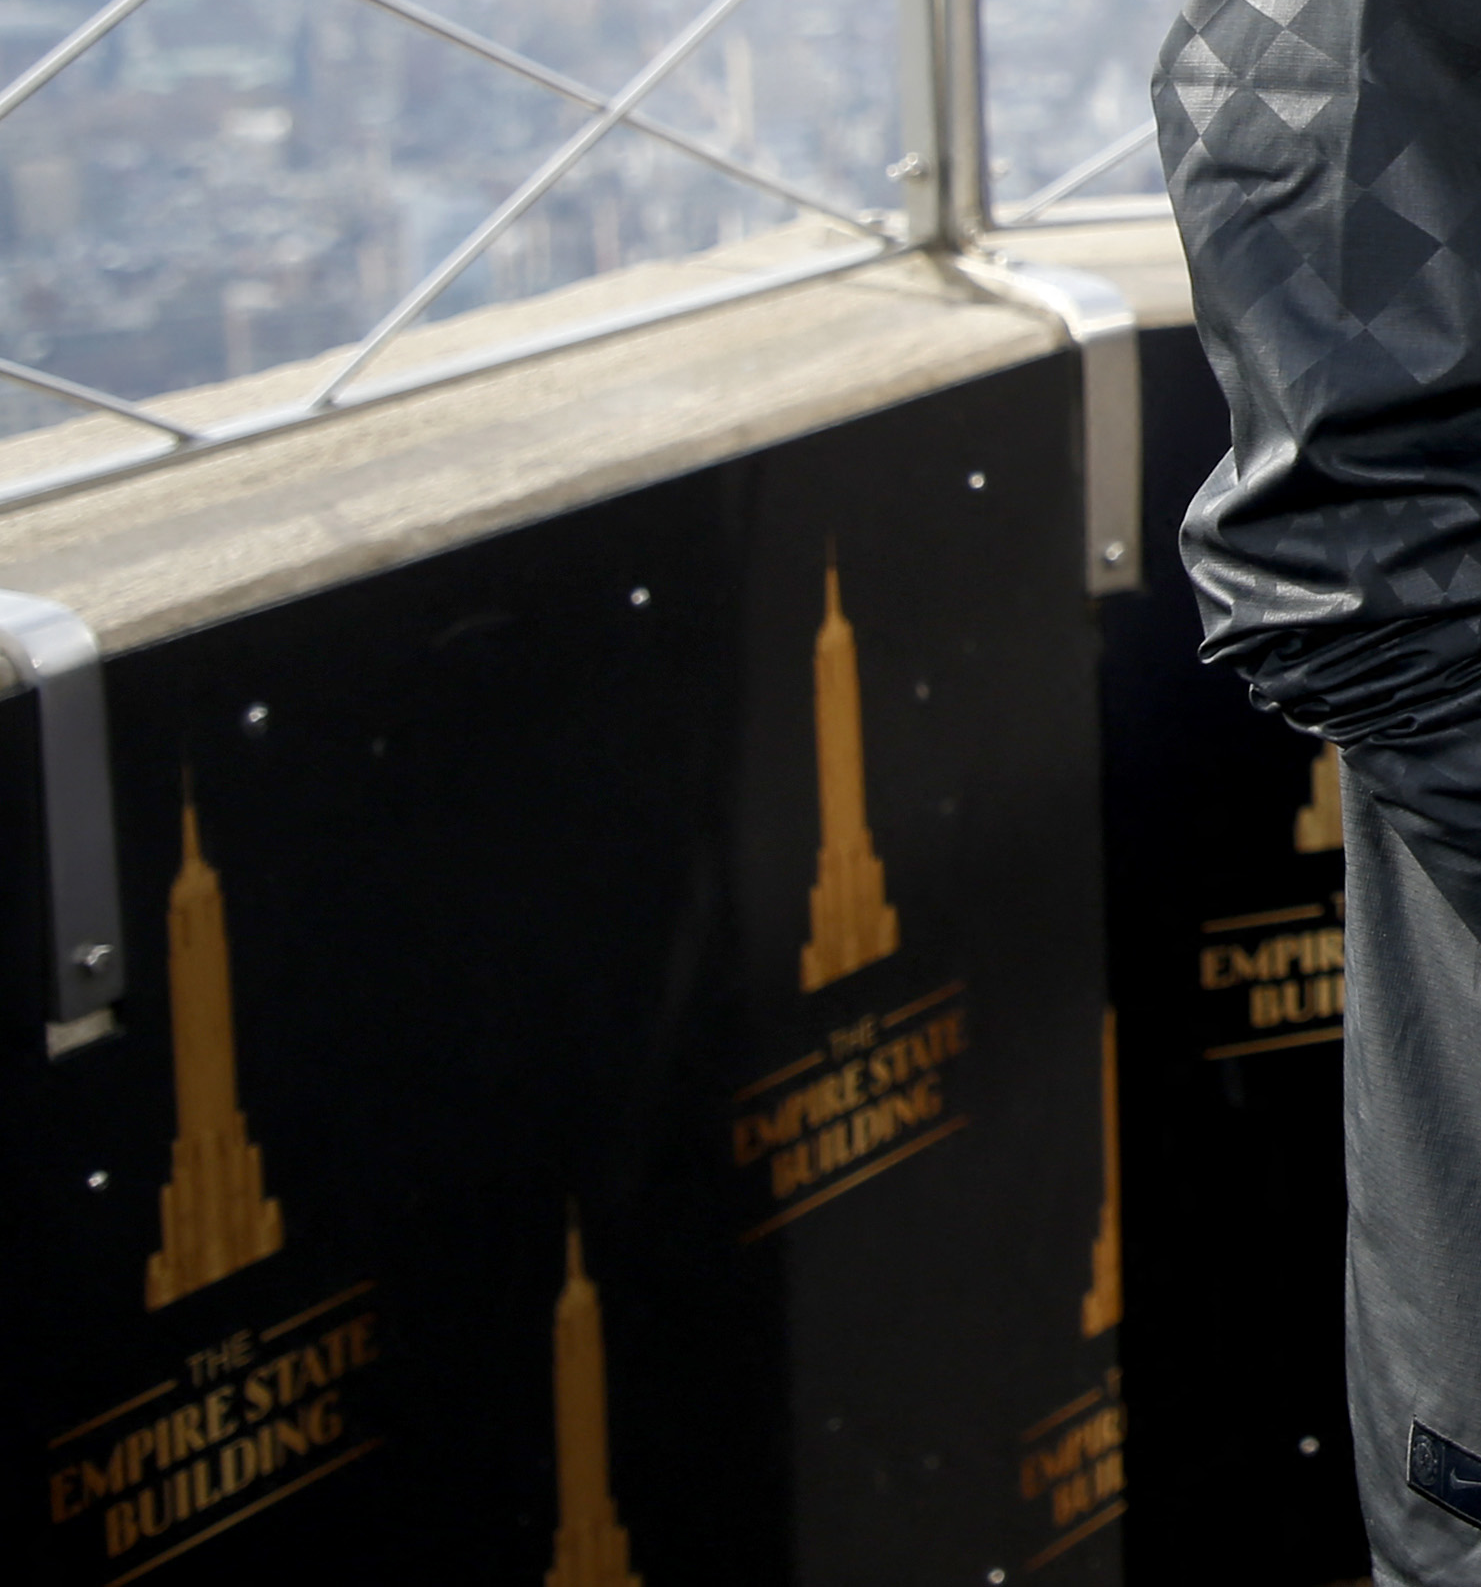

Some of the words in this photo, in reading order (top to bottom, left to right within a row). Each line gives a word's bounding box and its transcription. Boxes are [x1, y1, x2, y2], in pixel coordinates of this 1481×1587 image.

[1198, 926, 1345, 991] EMPIR
[732, 1058, 868, 1167] EMPIRE
[868, 1008, 968, 1095] STATE
[828, 1013, 879, 1062] THE
[771, 1070, 943, 1198] BUILDING
[49, 1384, 241, 1525] EMPIRE
[243, 1311, 383, 1424] STATE
[185, 1327, 255, 1389] THE
[104, 1389, 344, 1560] BUILDING
